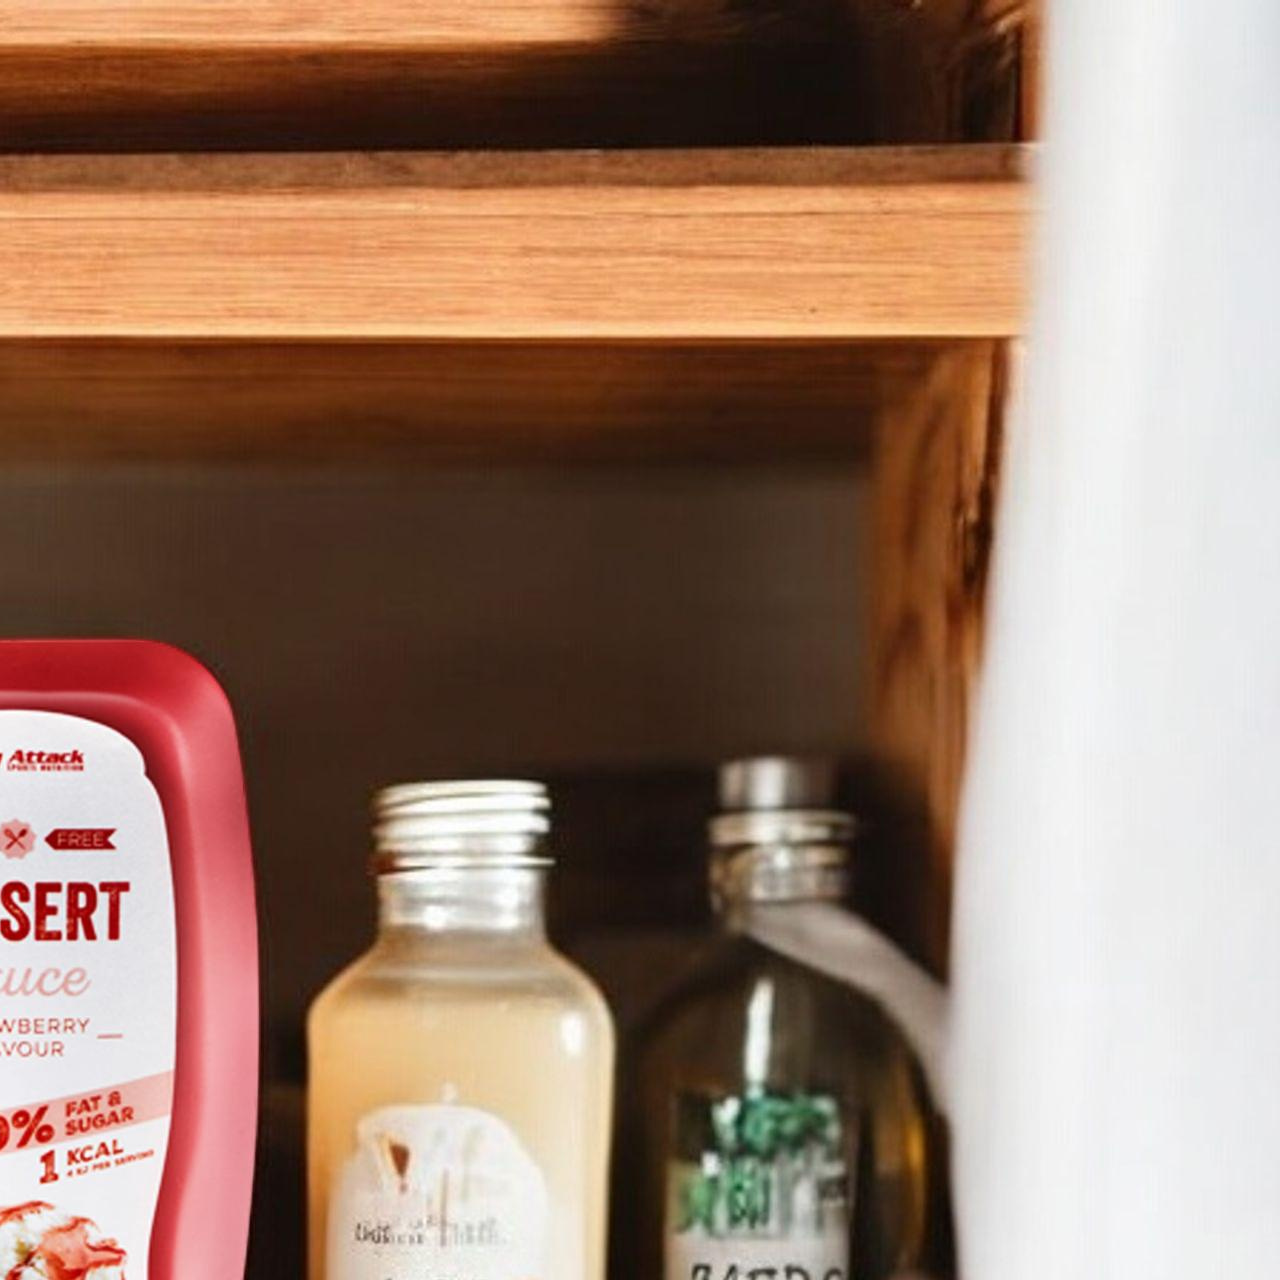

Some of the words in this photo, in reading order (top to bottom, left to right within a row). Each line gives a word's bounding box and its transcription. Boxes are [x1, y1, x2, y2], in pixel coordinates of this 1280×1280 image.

[8, 749, 84, 764] Attack
[57, 832, 105, 848] FREE
[65, 1094, 102, 1117] FAT
[65, 1106, 134, 1136] SUGAR
[66, 1139, 124, 1166] KCAL
[39, 1149, 59, 1184] 1
[92, 1160, 111, 1171] PER
